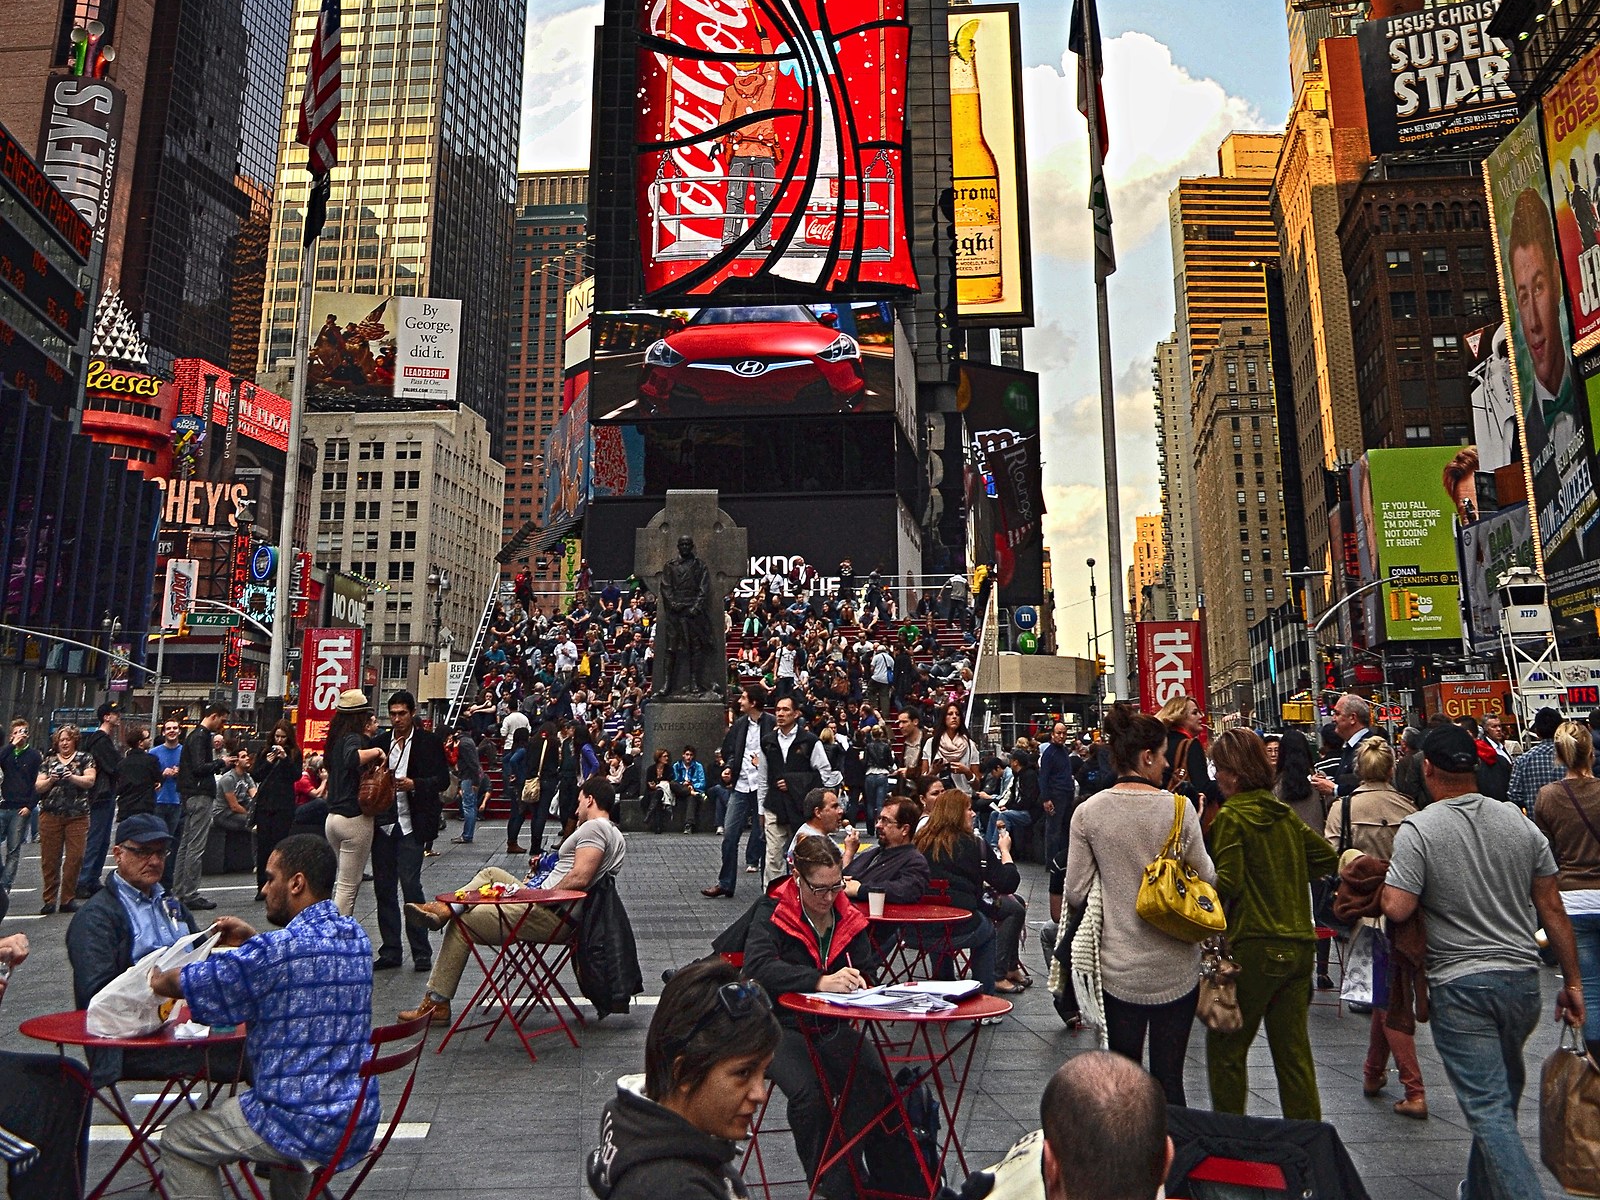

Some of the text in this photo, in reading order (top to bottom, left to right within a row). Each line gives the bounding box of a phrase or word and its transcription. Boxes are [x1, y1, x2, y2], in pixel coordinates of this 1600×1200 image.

[1386, 12, 1435, 39] JESUS
[1389, 20, 1510, 73] SUPER
[1394, 55, 1517, 118] STAR
[1549, 71, 1582, 116] THE
[1553, 86, 1599, 143] GOES
[98, 137, 117, 224] Chocolate
[423, 303, 439, 320] By
[405, 316, 454, 334] George,
[420, 334, 438, 344] we
[410, 344, 445, 359] did it.
[87, 360, 163, 397] Reese's
[404, 367, 447, 378] LEADERSHIP
[198, 386, 212, 457] HERSS
[223, 388, 237, 459] HERSHEYS
[1382, 501, 1427, 510] IF YOU FALL
[1539, 499, 1557, 546] HOW
[1558, 455, 1593, 522] SUCCEE
[1383, 509, 1441, 520] ASLEEP BEFORE
[1384, 519, 1437, 529] I'M DONE, I'M
[1385, 528, 1428, 538] NOT DOING
[1386, 538, 1422, 547] IT RIGHT.
[1391, 567, 1417, 576] CONAN
[1393, 575, 1438, 585] WEEKNIGHTS
[1440, 574, 1449, 583] @
[226, 534, 250, 668] HERSYS
[331, 591, 347, 620] NO
[196, 615, 230, 624] W 47 St
[1520, 609, 1537, 618] NYPD
[313, 635, 352, 711] tkts
[1153, 628, 1192, 708] tkts
[1454, 685, 1491, 695] Playland
[1446, 698, 1503, 716] GIFTS
